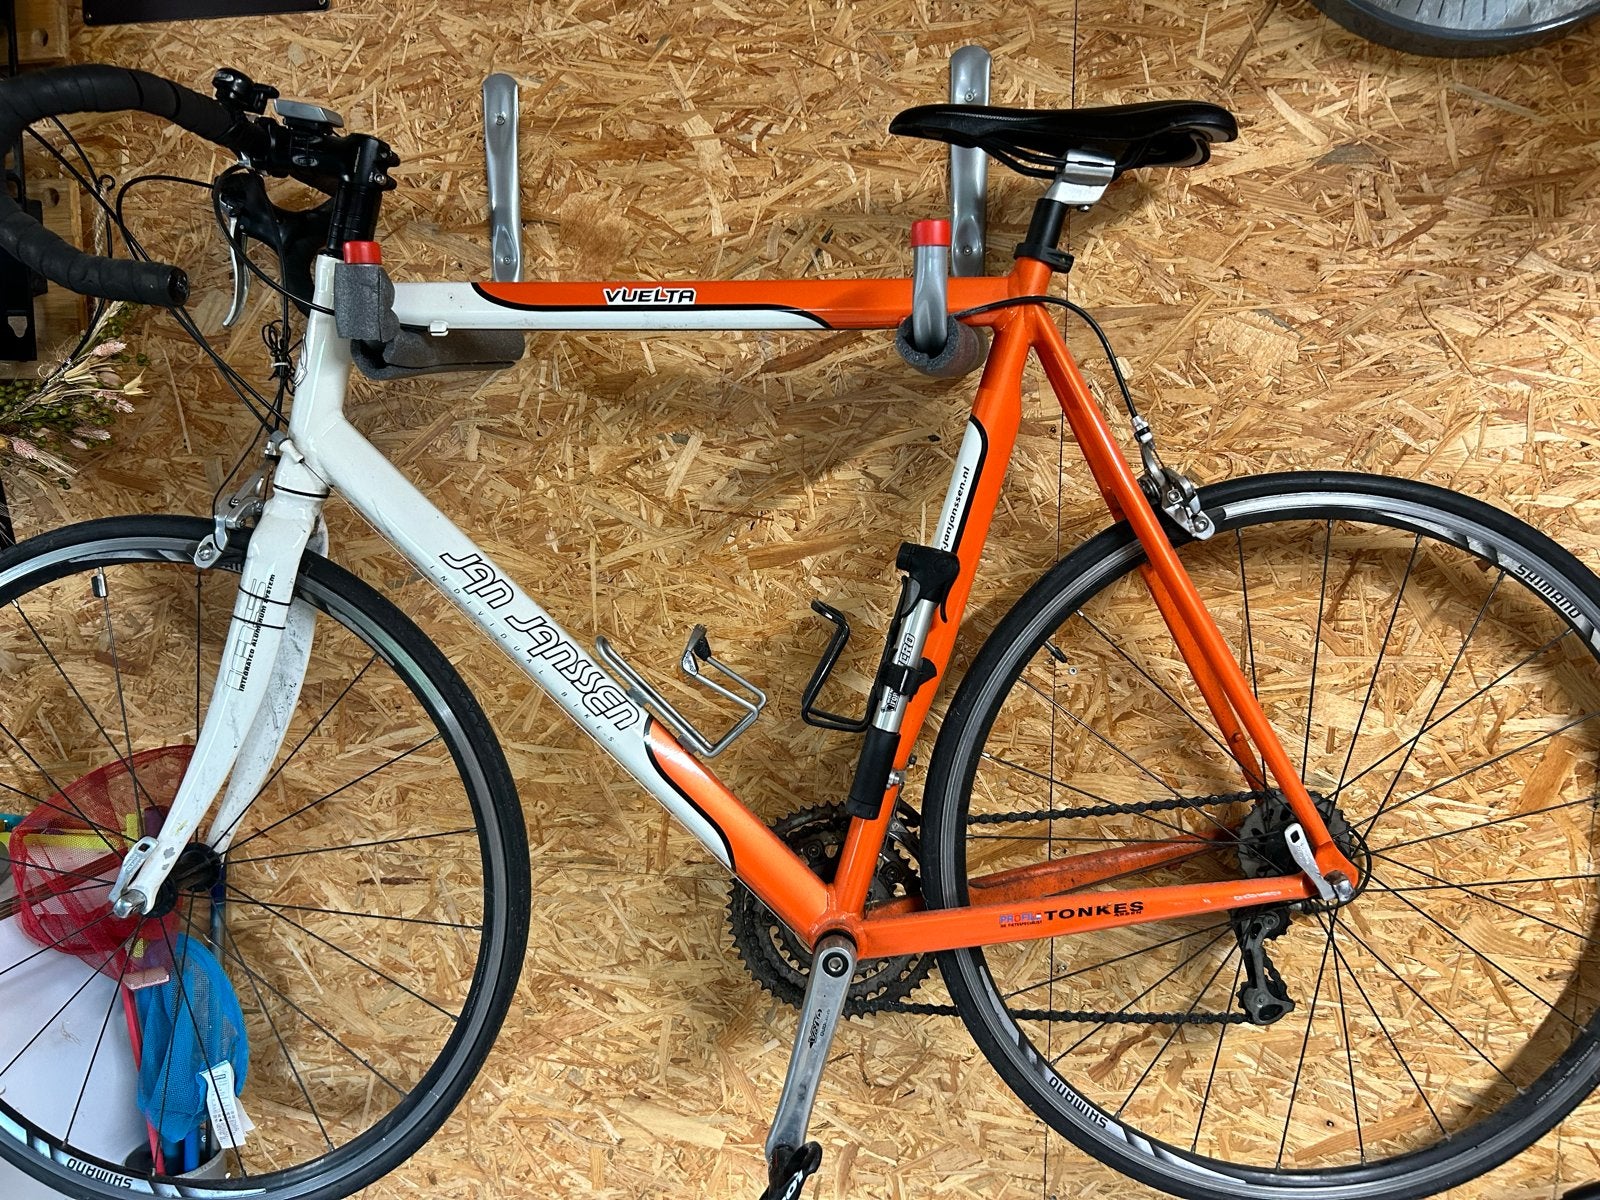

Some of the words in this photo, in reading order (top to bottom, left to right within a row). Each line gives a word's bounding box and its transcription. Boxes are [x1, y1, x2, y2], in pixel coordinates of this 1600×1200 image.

[604, 287, 695, 304] VUELTA
[1515, 564, 1581, 618] SHIMANO
[239, 648, 255, 692] INTEGRATED
[250, 605, 267, 647] ALUMNUM
[429, 564, 544, 675] INDIVIDUAL
[560, 691, 615, 742] BIKES
[439, 552, 514, 609] JAN
[504, 615, 640, 731] JANSSEN
[1044, 901, 1144, 921] TONKES
[1049, 1076, 1109, 1129] SHIMANO
[66, 1157, 133, 1189] SHIMANO
